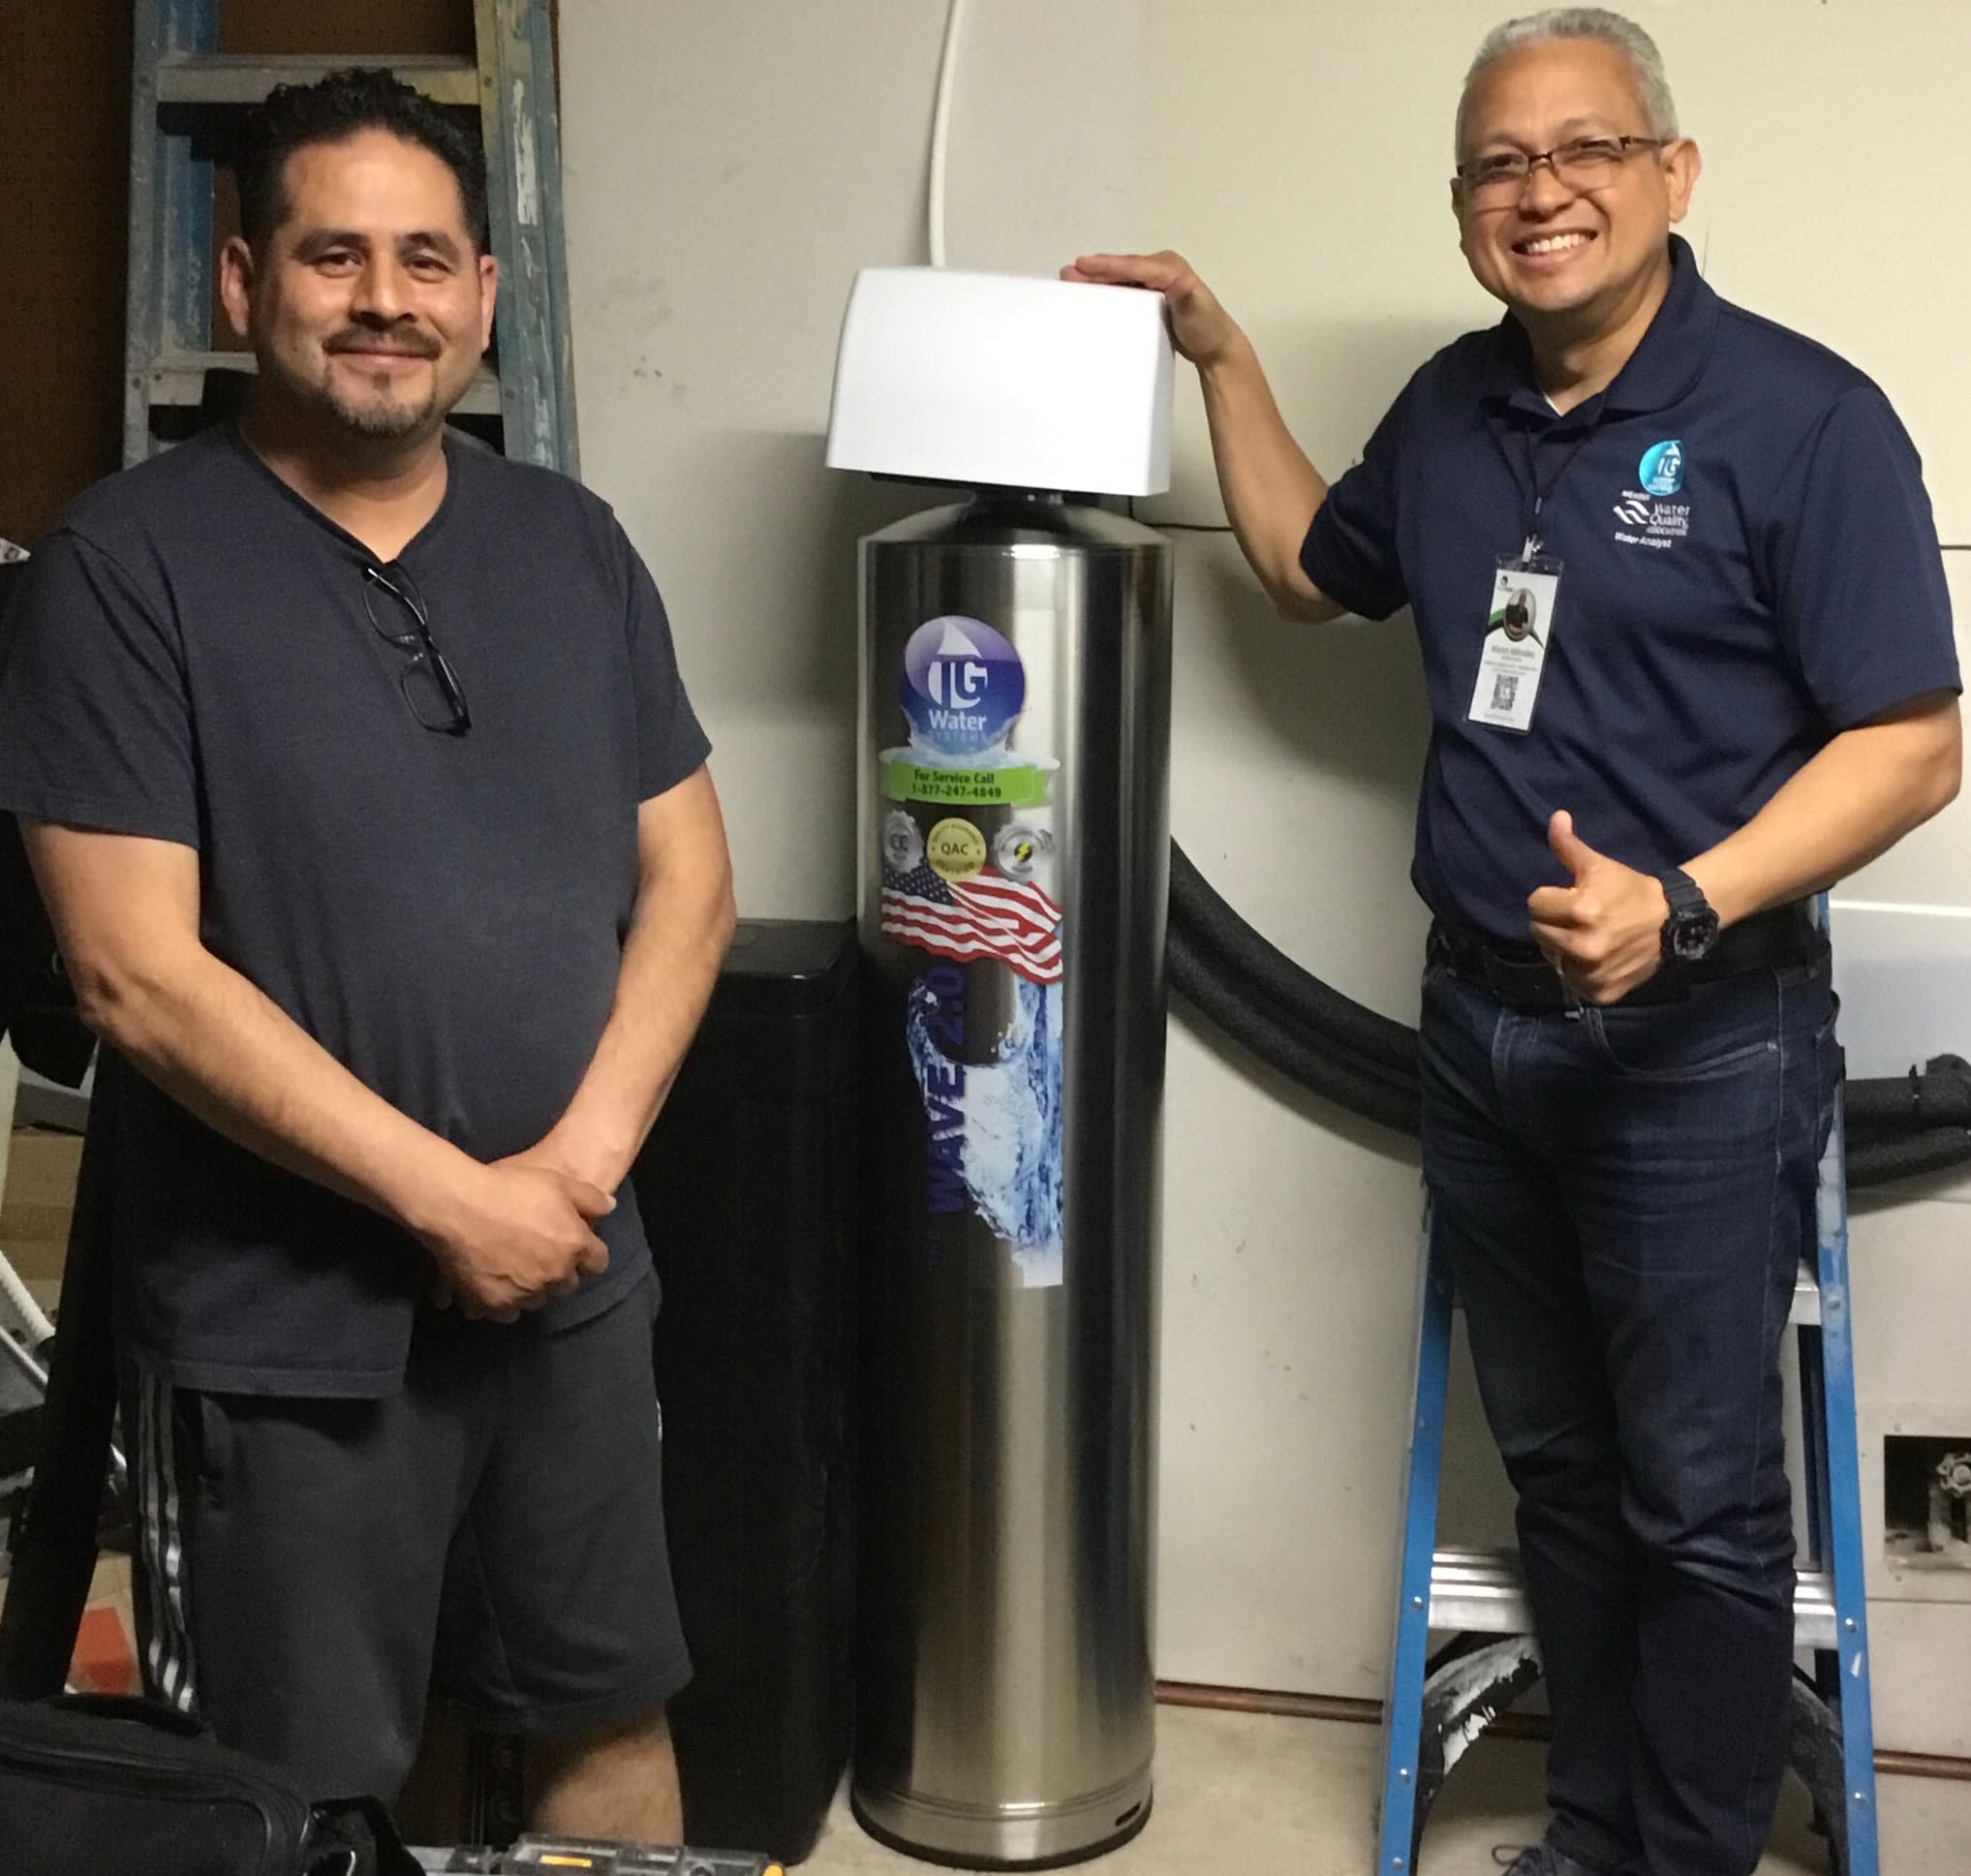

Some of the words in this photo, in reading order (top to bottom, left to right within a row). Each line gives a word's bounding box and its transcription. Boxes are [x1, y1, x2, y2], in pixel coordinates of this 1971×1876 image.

[1654, 504, 1690, 515] Water
[1649, 513, 1689, 529] Quality
[1615, 532, 1639, 544] Water
[1639, 536, 1673, 548] Analyst
[928, 709, 987, 731] Water
[914, 767, 929, 781] For
[933, 770, 970, 784] Service
[973, 772, 995, 784] Call
[912, 783, 1001, 798] 1-877-247-4849
[940, 843, 969, 855] QAC
[924, 965, 966, 1045] 2.0
[927, 1064, 966, 1213] WAVE
